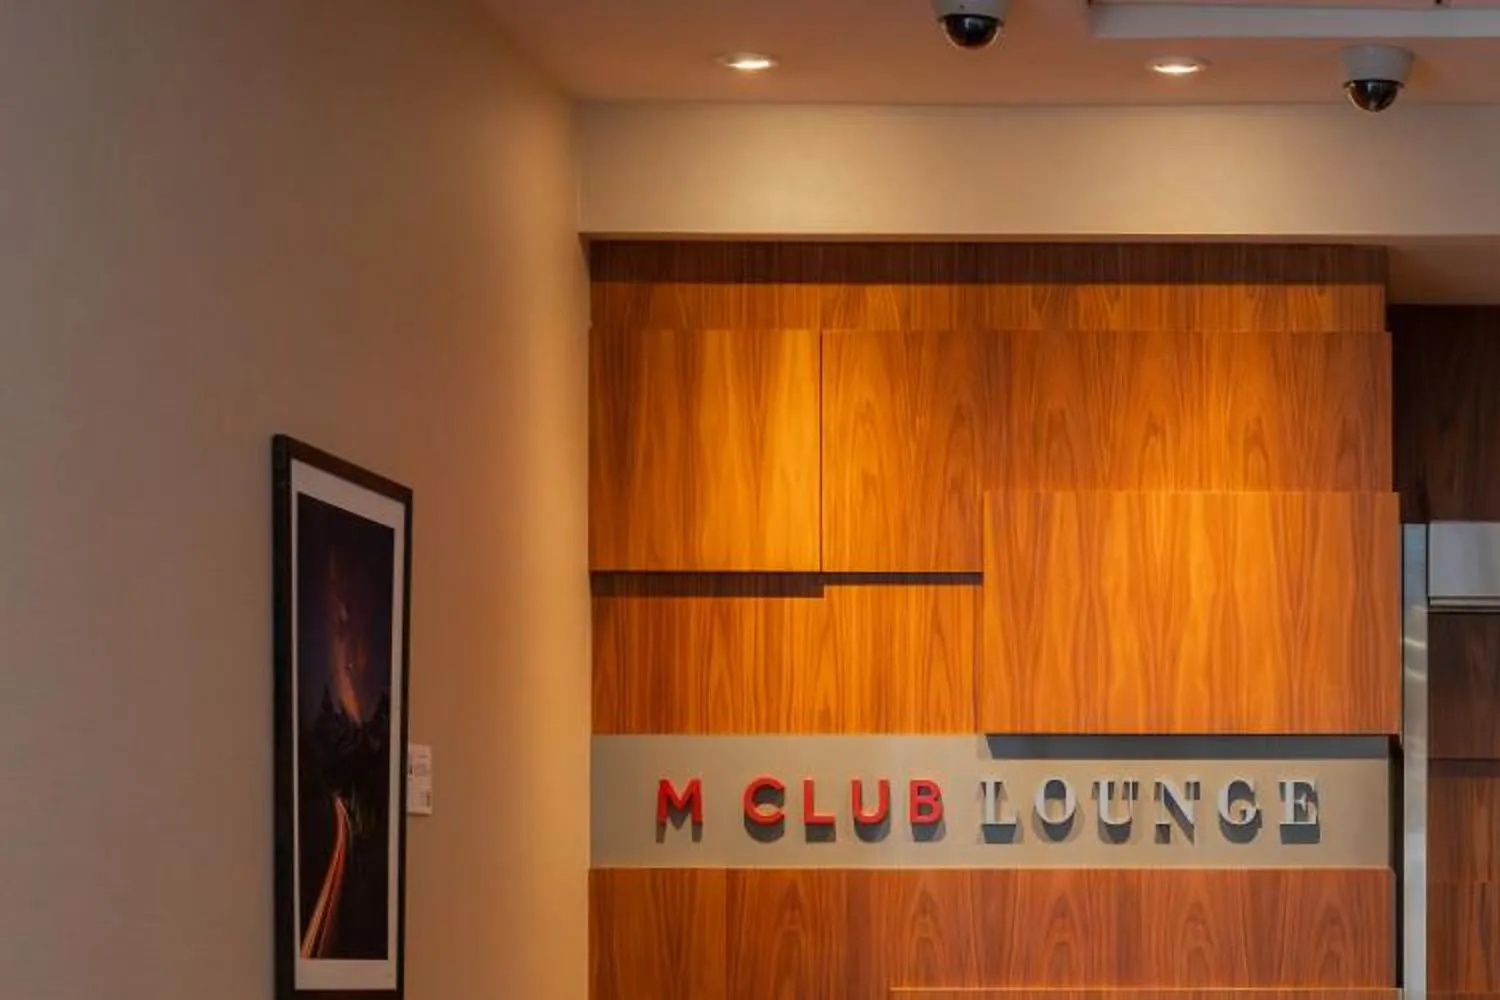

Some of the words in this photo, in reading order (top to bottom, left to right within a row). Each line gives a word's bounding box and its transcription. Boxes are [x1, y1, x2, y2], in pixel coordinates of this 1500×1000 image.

[657, 778, 703, 826] M
[744, 778, 941, 827] CLUB
[980, 778, 1321, 827] LOUNGE
